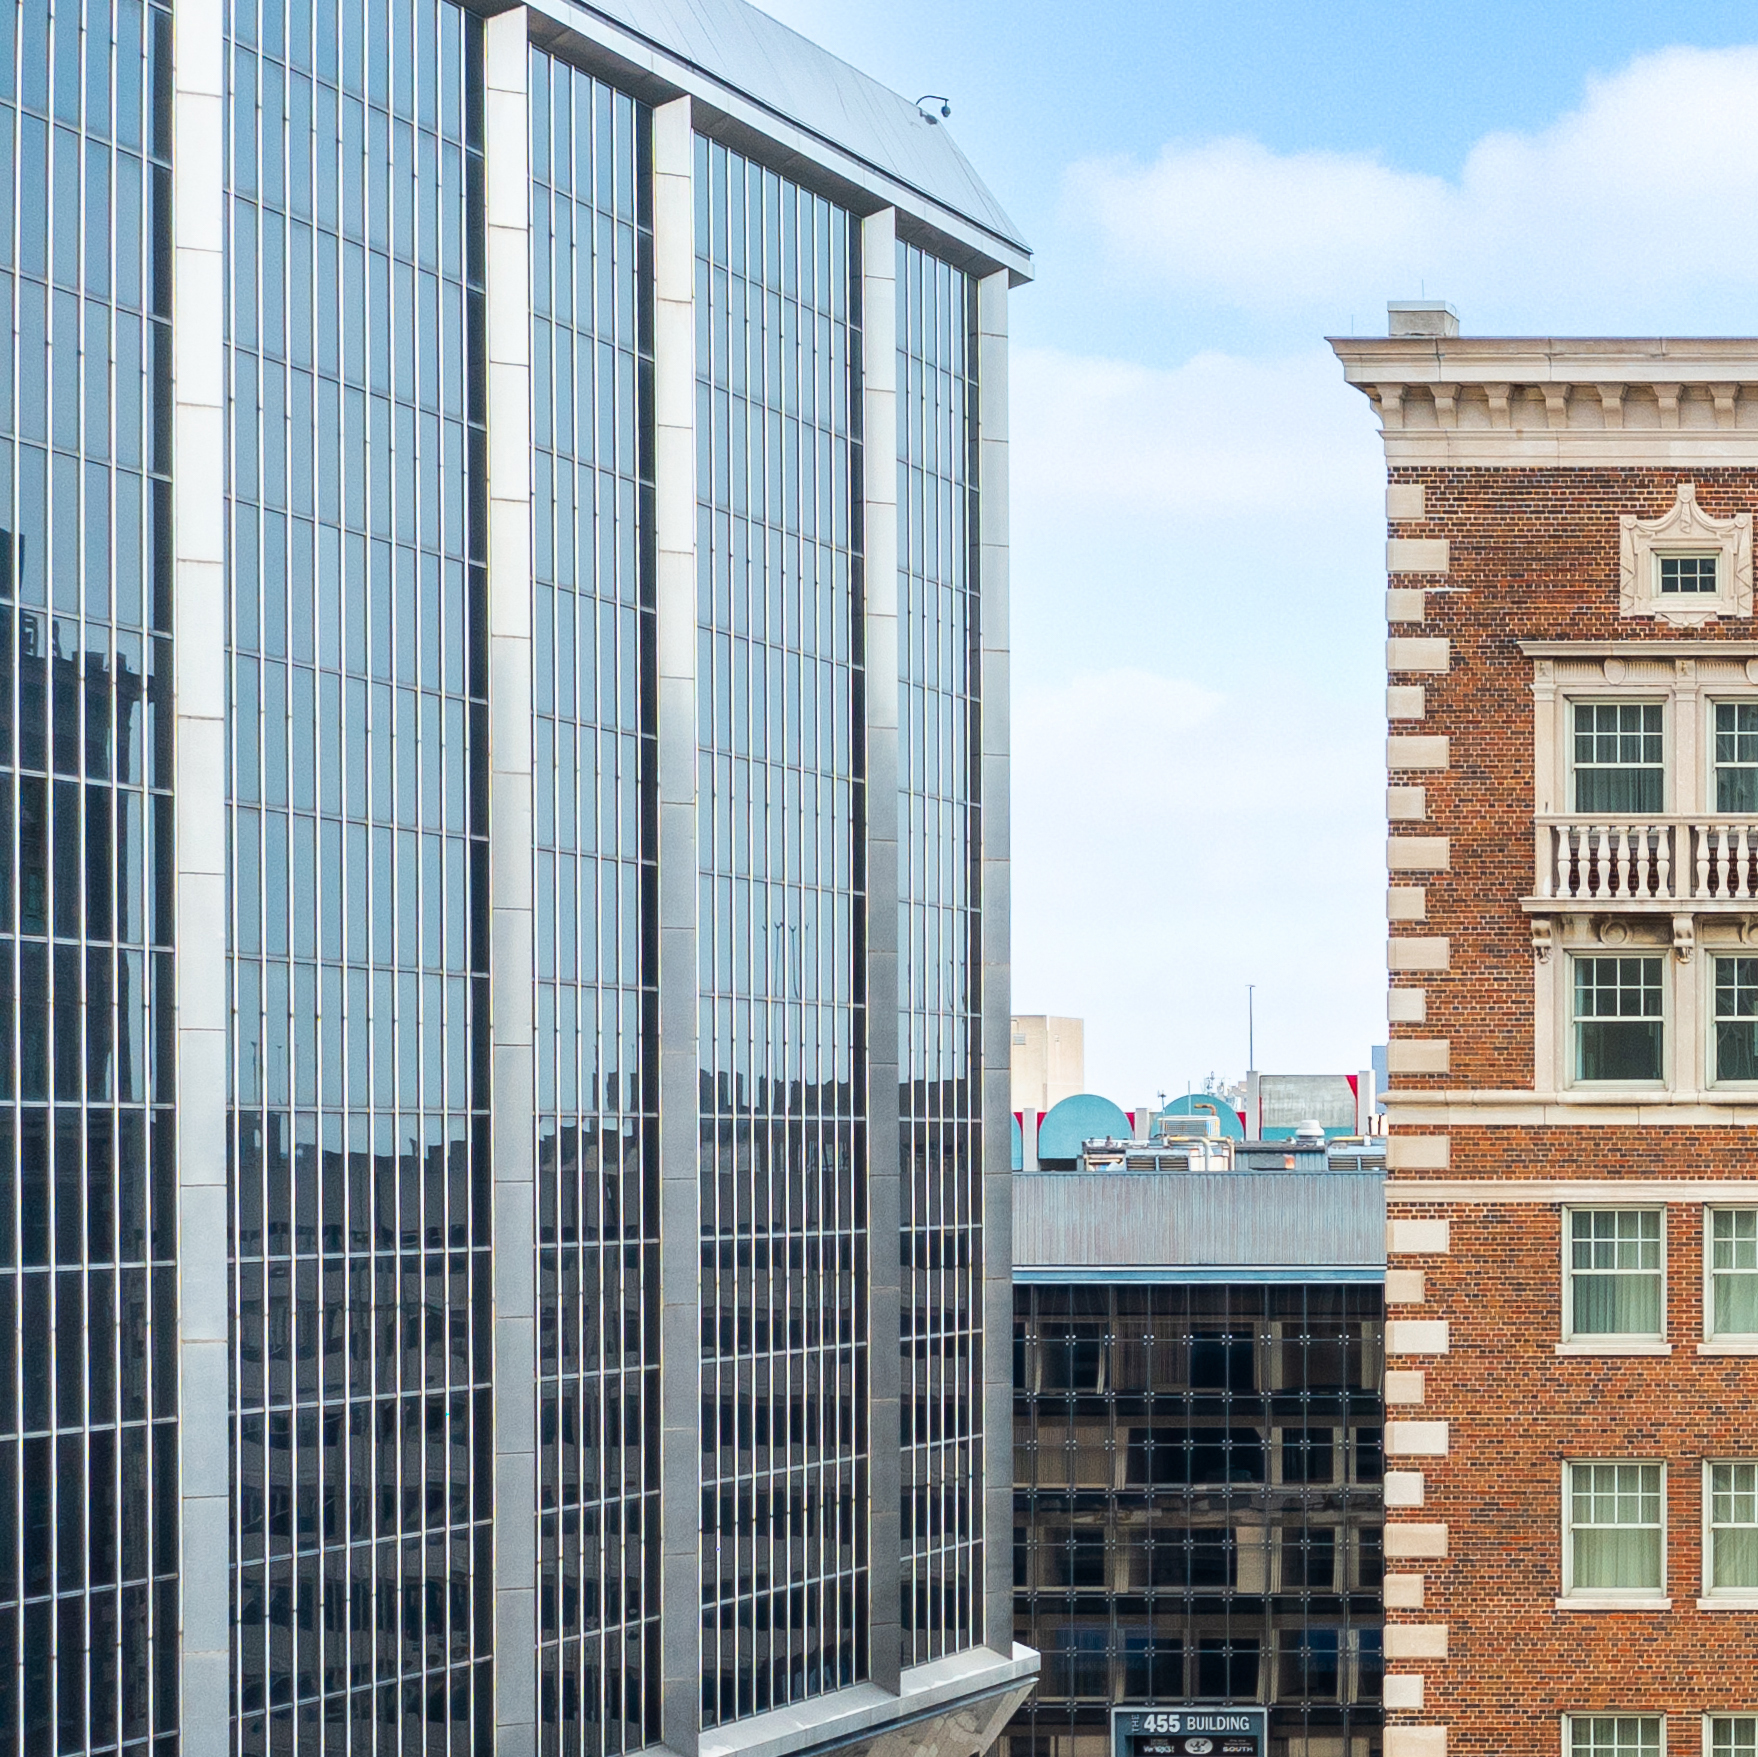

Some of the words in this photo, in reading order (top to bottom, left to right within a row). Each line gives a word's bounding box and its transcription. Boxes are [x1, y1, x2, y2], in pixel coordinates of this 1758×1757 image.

[1131, 1714, 1139, 1733] THE
[1143, 1714, 1181, 1733] 455
[1186, 1716, 1250, 1731] BUILDING
